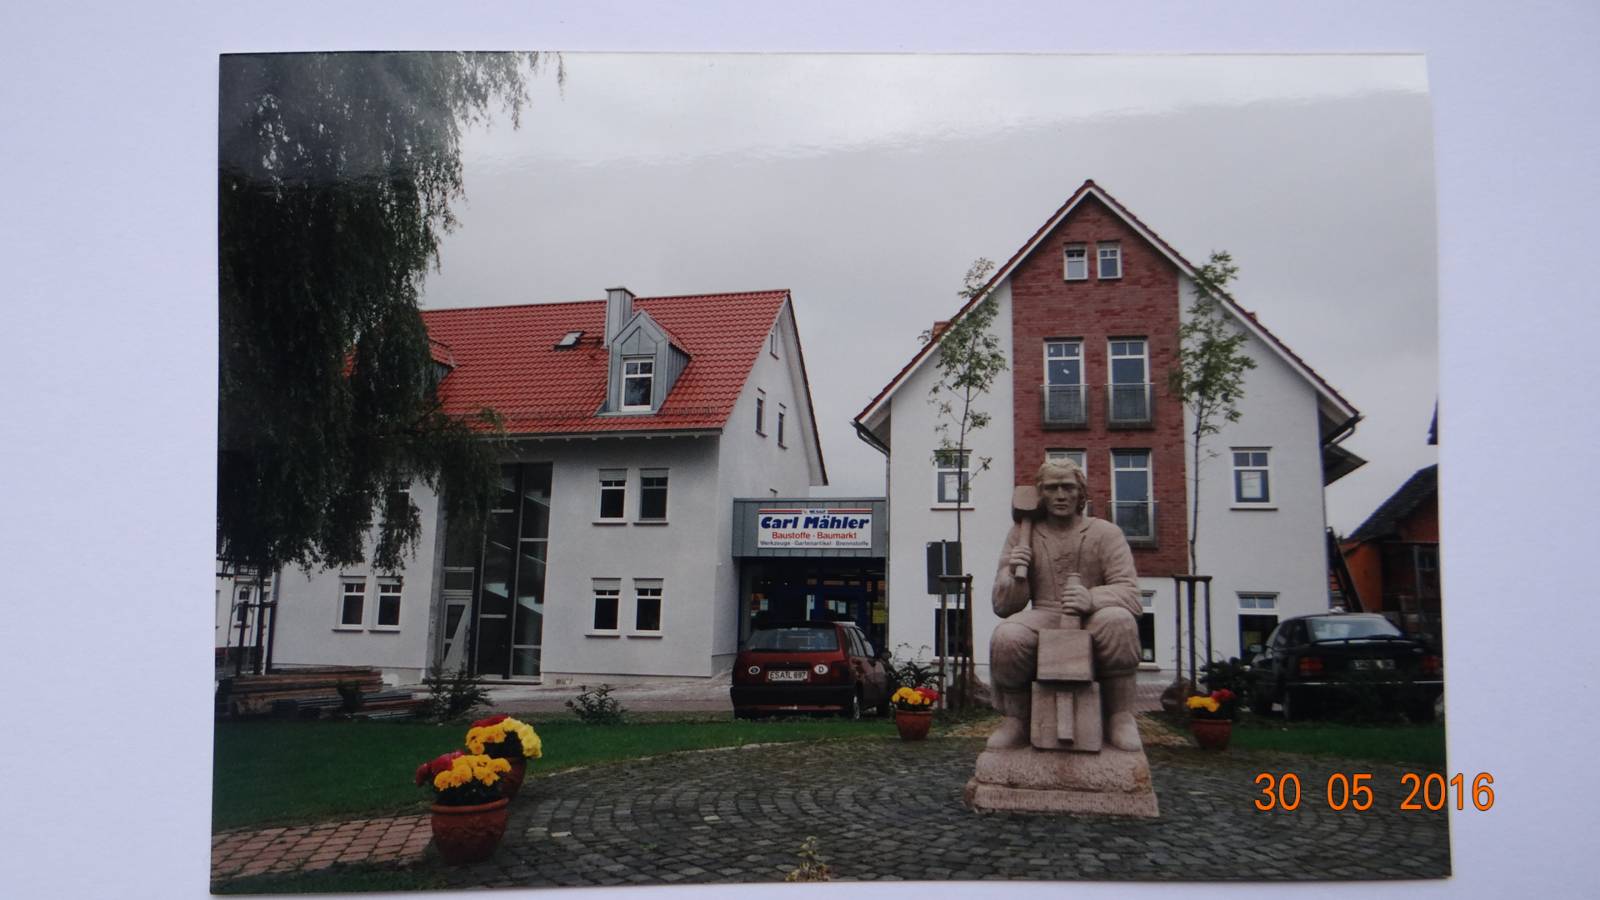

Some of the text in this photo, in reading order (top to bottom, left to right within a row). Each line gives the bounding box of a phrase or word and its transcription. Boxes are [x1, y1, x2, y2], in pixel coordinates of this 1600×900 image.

[761, 515, 869, 529] Carl Mähler
[771, 531, 857, 540] Baustoffe Baumarkt
